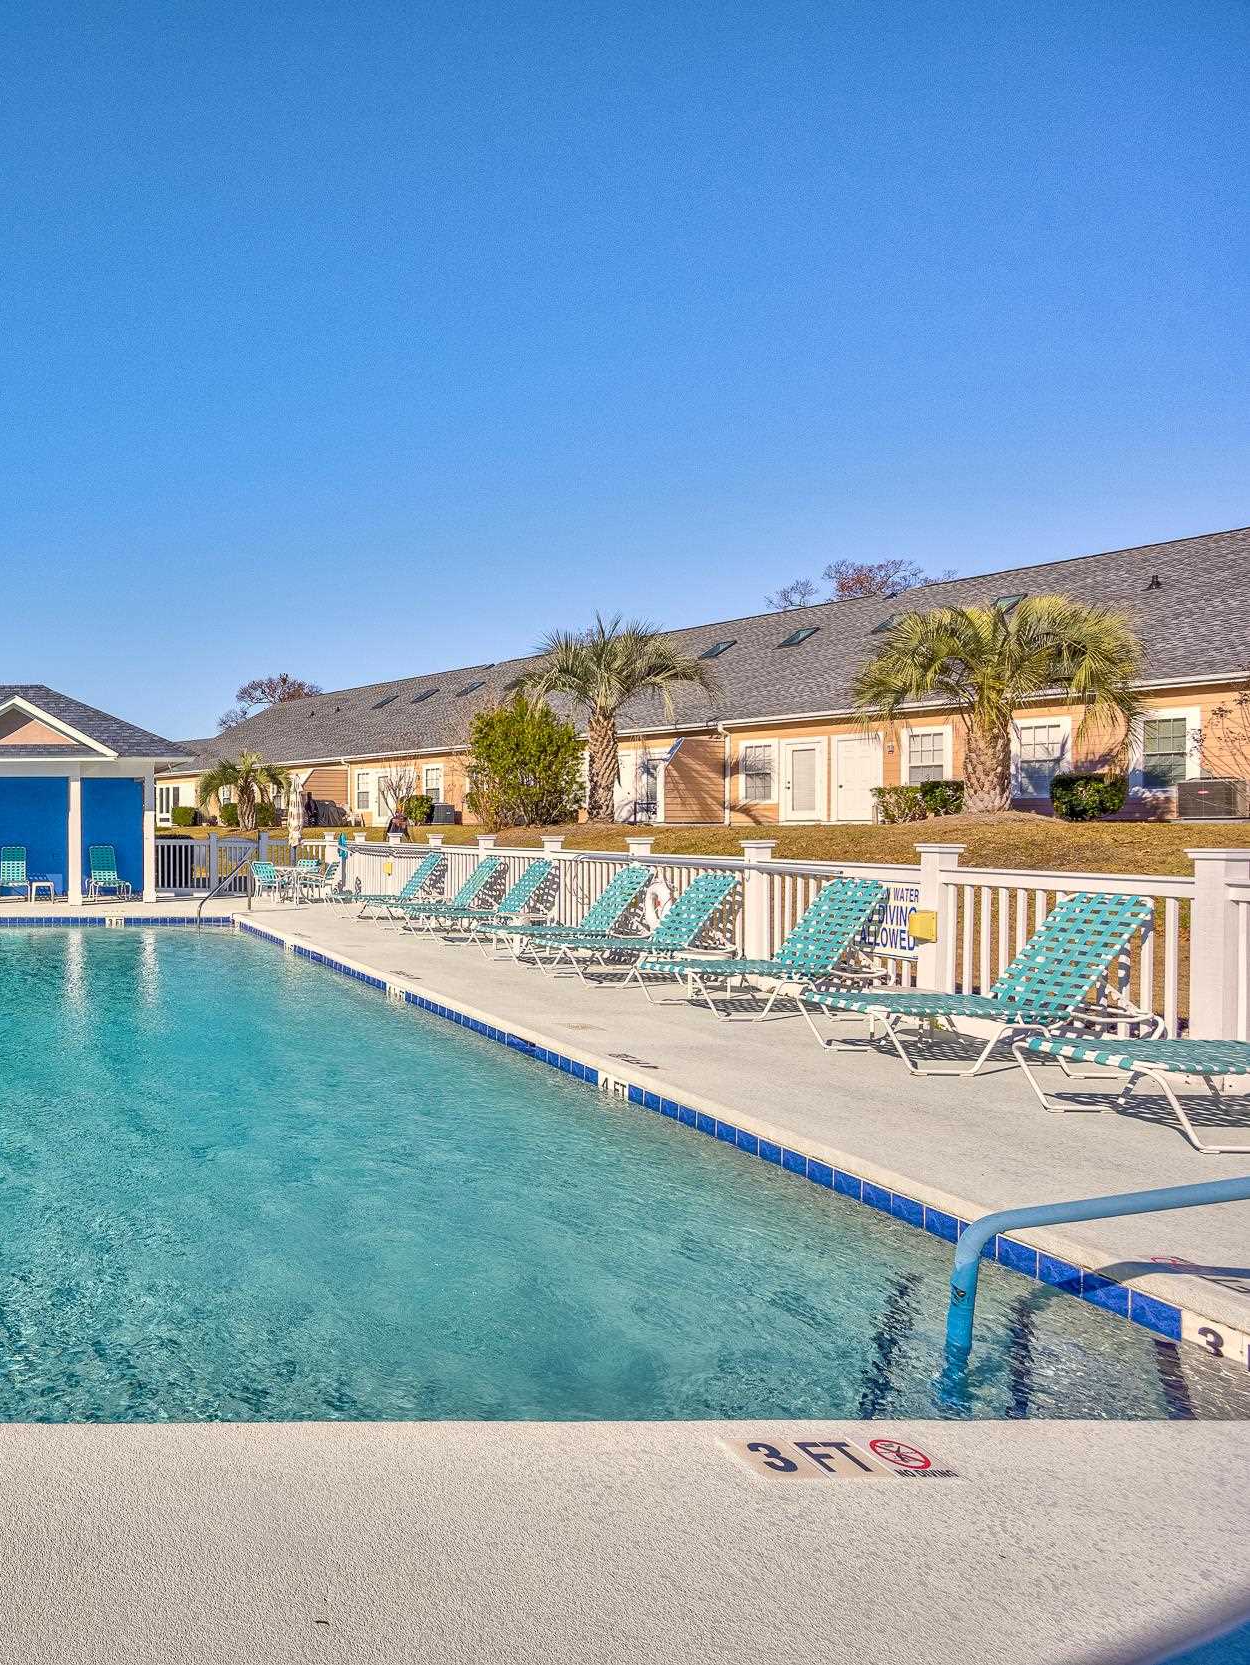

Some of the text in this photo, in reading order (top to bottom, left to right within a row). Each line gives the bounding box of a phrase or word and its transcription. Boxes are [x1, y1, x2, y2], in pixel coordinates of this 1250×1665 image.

[893, 887, 919, 903] WATER
[859, 925, 916, 951] ALLOWED
[746, 1441, 874, 1473] 3 FT
[893, 1468, 960, 1478] NO DIVING
